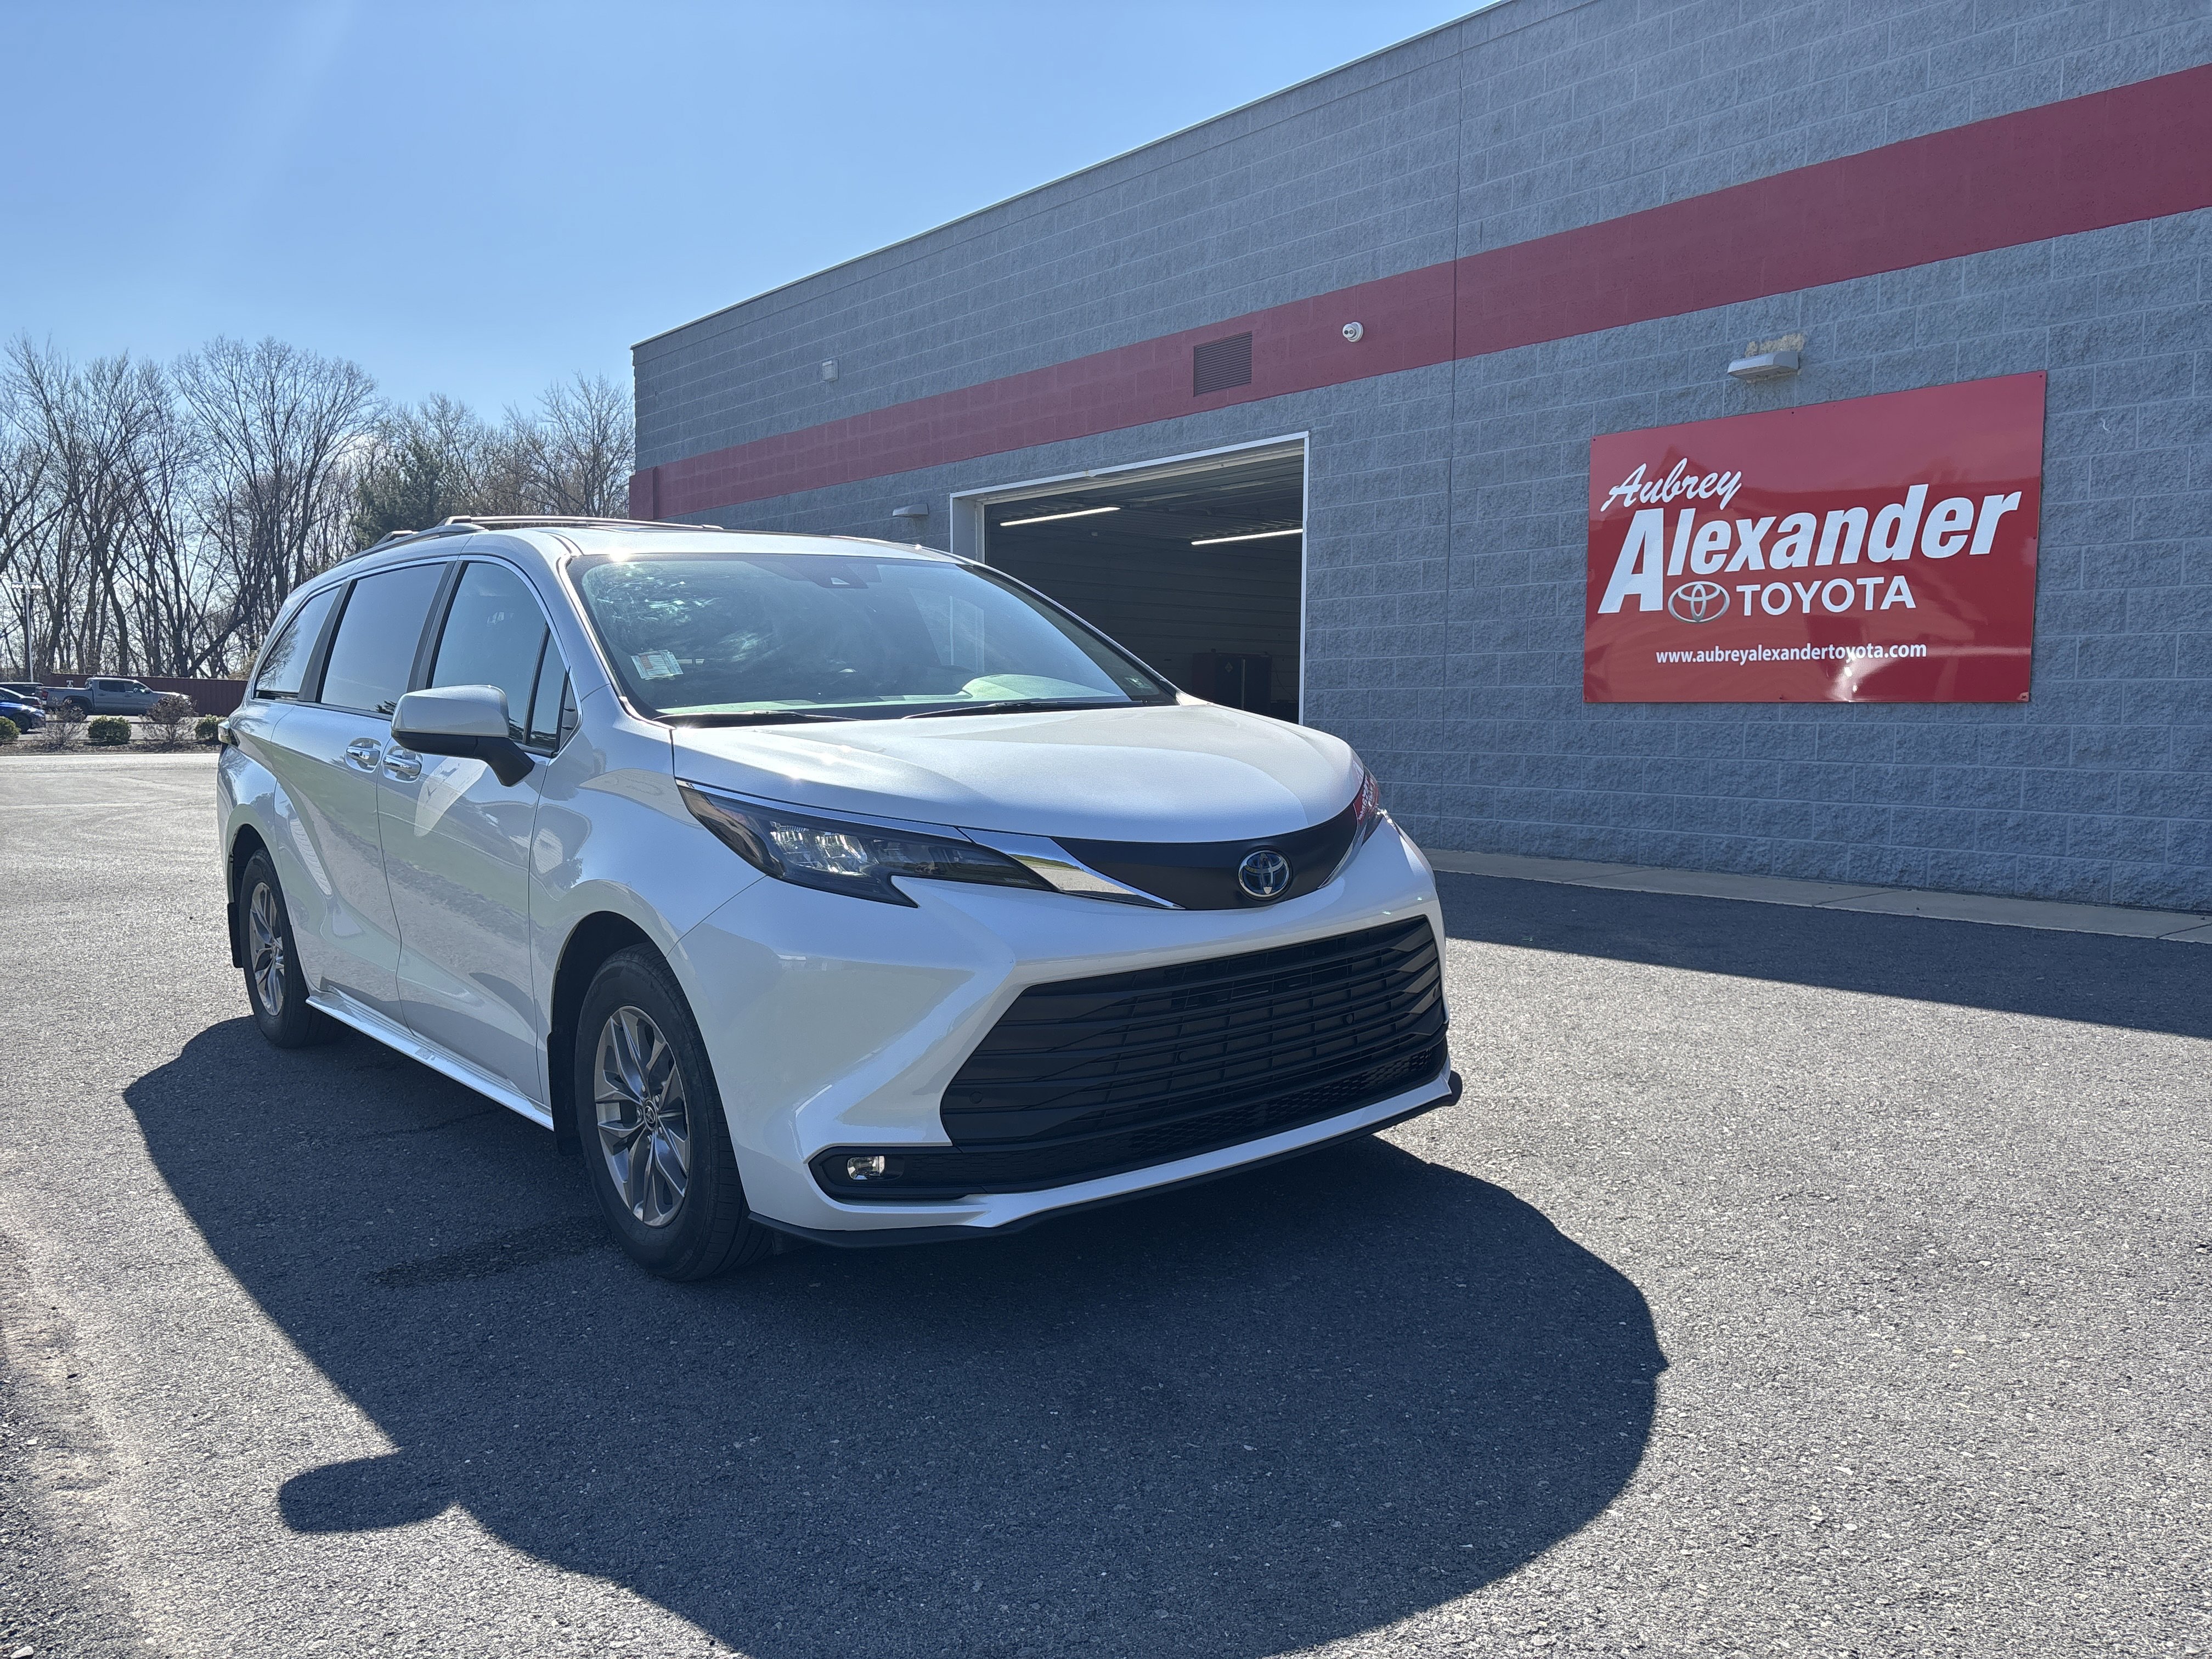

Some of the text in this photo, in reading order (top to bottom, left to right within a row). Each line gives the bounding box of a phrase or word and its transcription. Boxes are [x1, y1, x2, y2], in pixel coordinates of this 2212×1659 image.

[1600, 458, 1742, 511] Aubrey
[1597, 483, 2023, 614] Alexander
[1736, 575, 1916, 616] TOYOTA
[1656, 642, 1927, 665] www.aubreyalexandertoyota.com
